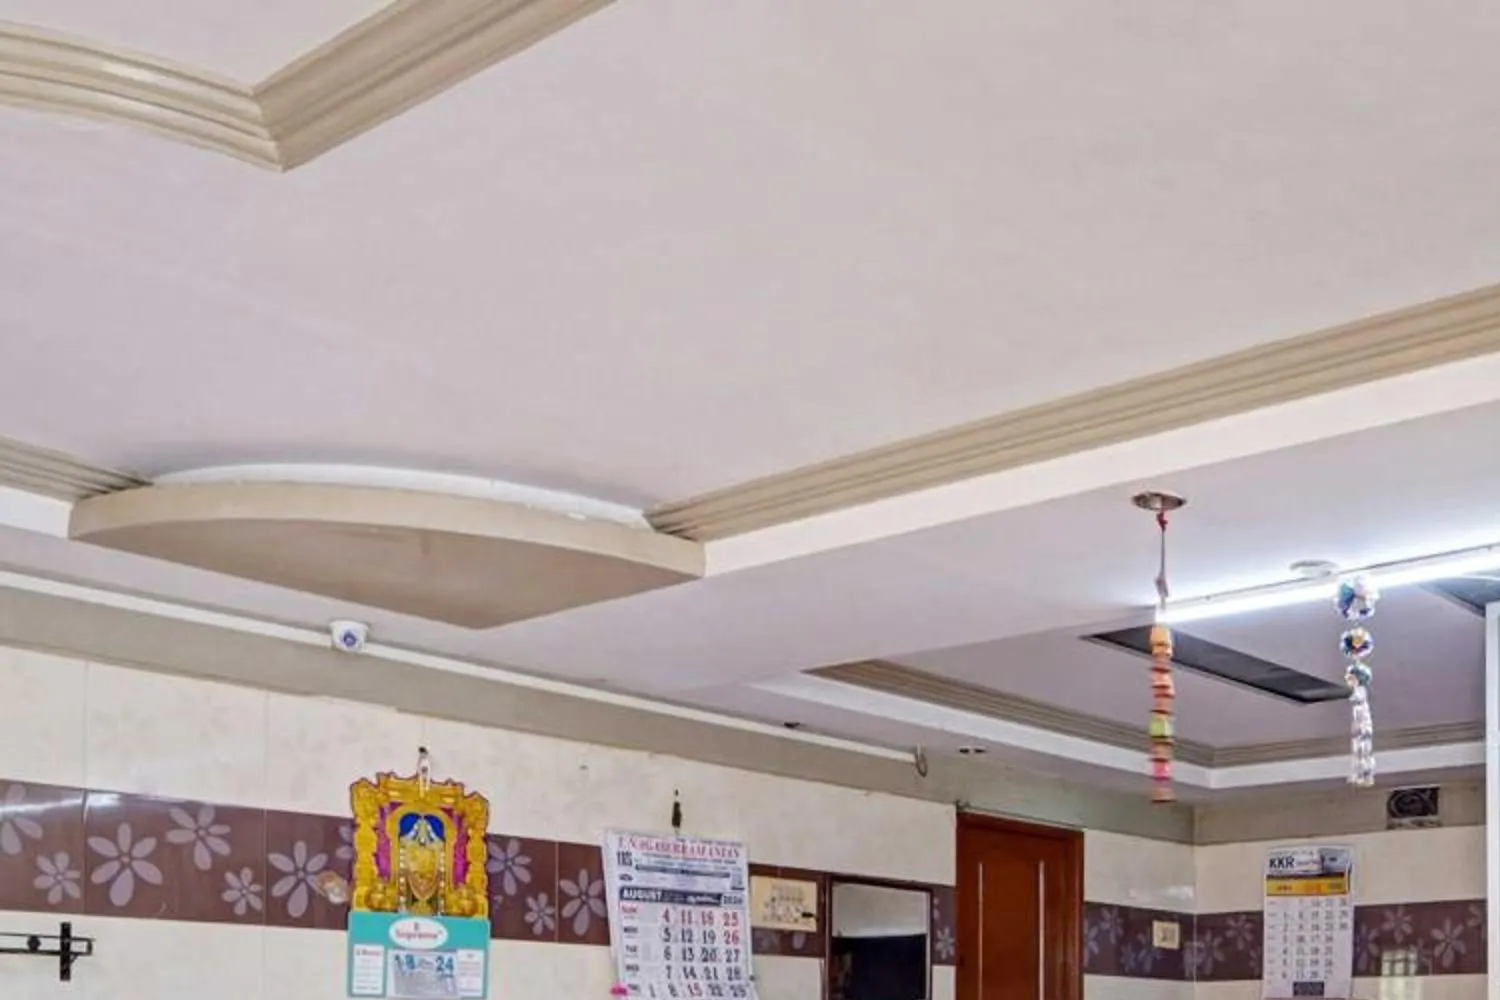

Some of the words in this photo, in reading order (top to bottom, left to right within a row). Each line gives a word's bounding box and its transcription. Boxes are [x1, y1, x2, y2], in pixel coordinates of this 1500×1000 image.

[1268, 856, 1295, 868] KKR
[623, 888, 661, 902] AUGUST
[662, 908, 670, 923] 4
[681, 910, 692, 925] 11
[723, 911, 738, 926] 25
[663, 927, 671, 942] 5
[681, 928, 693, 943] 12
[702, 929, 716, 944] 19
[723, 930, 740, 945] 26
[663, 946, 671, 961] 6
[682, 947, 694, 962] 13
[701, 947, 717, 962] 20
[725, 949, 740, 962] 27
[436, 955, 454, 972] 24
[665, 964, 671, 979] 7
[683, 966, 696, 980] 14
[703, 966, 719, 981] 21
[726, 966, 741, 981] 28
[649, 984, 656, 998] 1
[687, 983, 702, 997] 15
[707, 984, 723, 997] 22
[729, 984, 746, 998] 29
